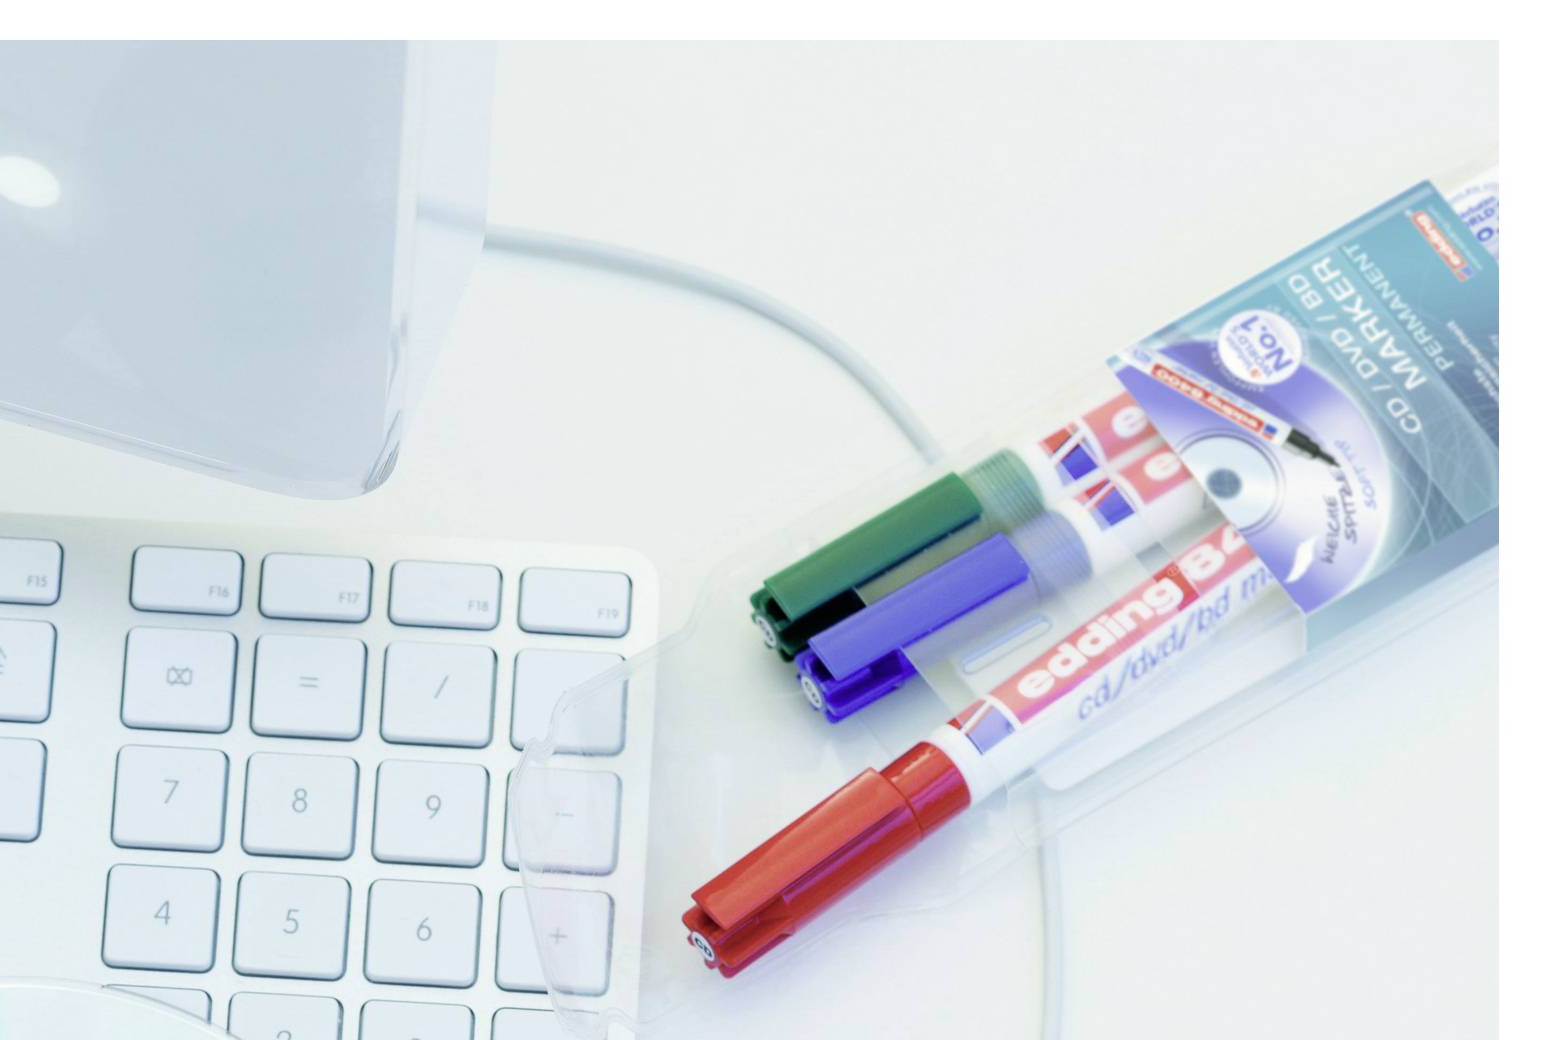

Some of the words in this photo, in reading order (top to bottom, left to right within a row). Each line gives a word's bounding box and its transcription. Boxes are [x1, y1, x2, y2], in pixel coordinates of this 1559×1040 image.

[1288, 274, 1324, 310] BD
[1342, 244, 1454, 371] PERMANENT
[1312, 256, 1427, 391] MARKER
[1239, 314, 1294, 372] No.1
[1330, 327, 1379, 380] DVD
[1386, 397, 1422, 434] CD
[25, 574, 49, 589] F15
[207, 584, 231, 599] F16
[337, 590, 361, 605] F17
[467, 599, 490, 613] F18
[596, 607, 620, 622] F19
[1016, 576, 1185, 700] edding
[1177, 530, 1241, 587] 84
[1077, 585, 1231, 721] cd/dvd/bd
[433, 674, 450, 700] /
[163, 778, 181, 805] 7
[290, 787, 309, 814] 8
[424, 793, 443, 820] 9
[153, 899, 172, 926] 4
[282, 907, 300, 935] 5
[415, 916, 433, 943] 6
[548, 927, 569, 945] +
